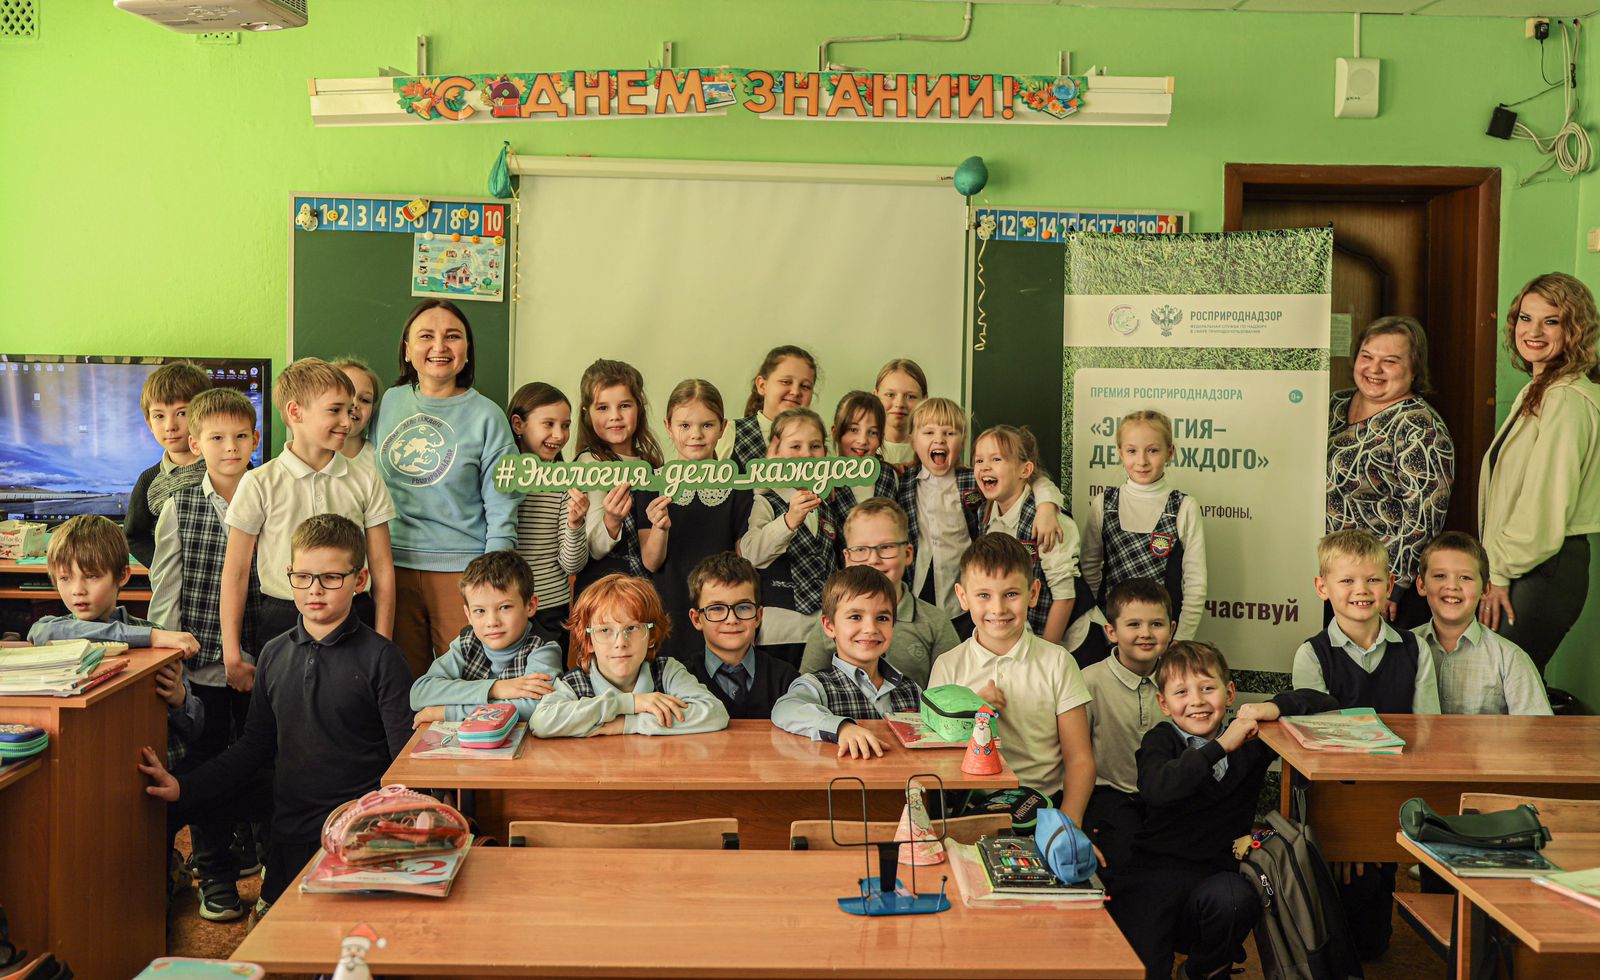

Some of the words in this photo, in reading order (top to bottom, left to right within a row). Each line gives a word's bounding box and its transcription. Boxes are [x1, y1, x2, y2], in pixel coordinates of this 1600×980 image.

[434, 77, 476, 120] С
[519, 69, 707, 118] ДНЕМ
[743, 71, 1015, 120] ЗНАНИЙ!
[320, 203, 329, 225] 1
[338, 204, 349, 226] 2
[356, 205, 367, 227] 3
[375, 206, 387, 227] 4
[394, 206, 405, 228] 5
[432, 208, 443, 229] 7
[449, 208, 462, 230] 8
[468, 210, 480, 231] 9
[485, 210, 502, 232] 10
[1000, 215, 1016, 236] 12
[1190, 311, 1283, 322] РОСПРИРОДНАДЗОР
[1090, 387, 1130, 398] ПРЕМИЯ
[1133, 388, 1243, 400] РОСПРИРОДНАДЗОРА
[1090, 416, 1227, 439] «ЭГИЯ–
[1166, 446, 1270, 472] АЖДОГО»
[495, 457, 651, 488] #Экология
[1200, 505, 1253, 520] РТФОНЫ,
[1204, 598, 1299, 625] частвуй
[1014, 794, 1042, 820] MINECRAFT
[410, 859, 448, 876] 2
